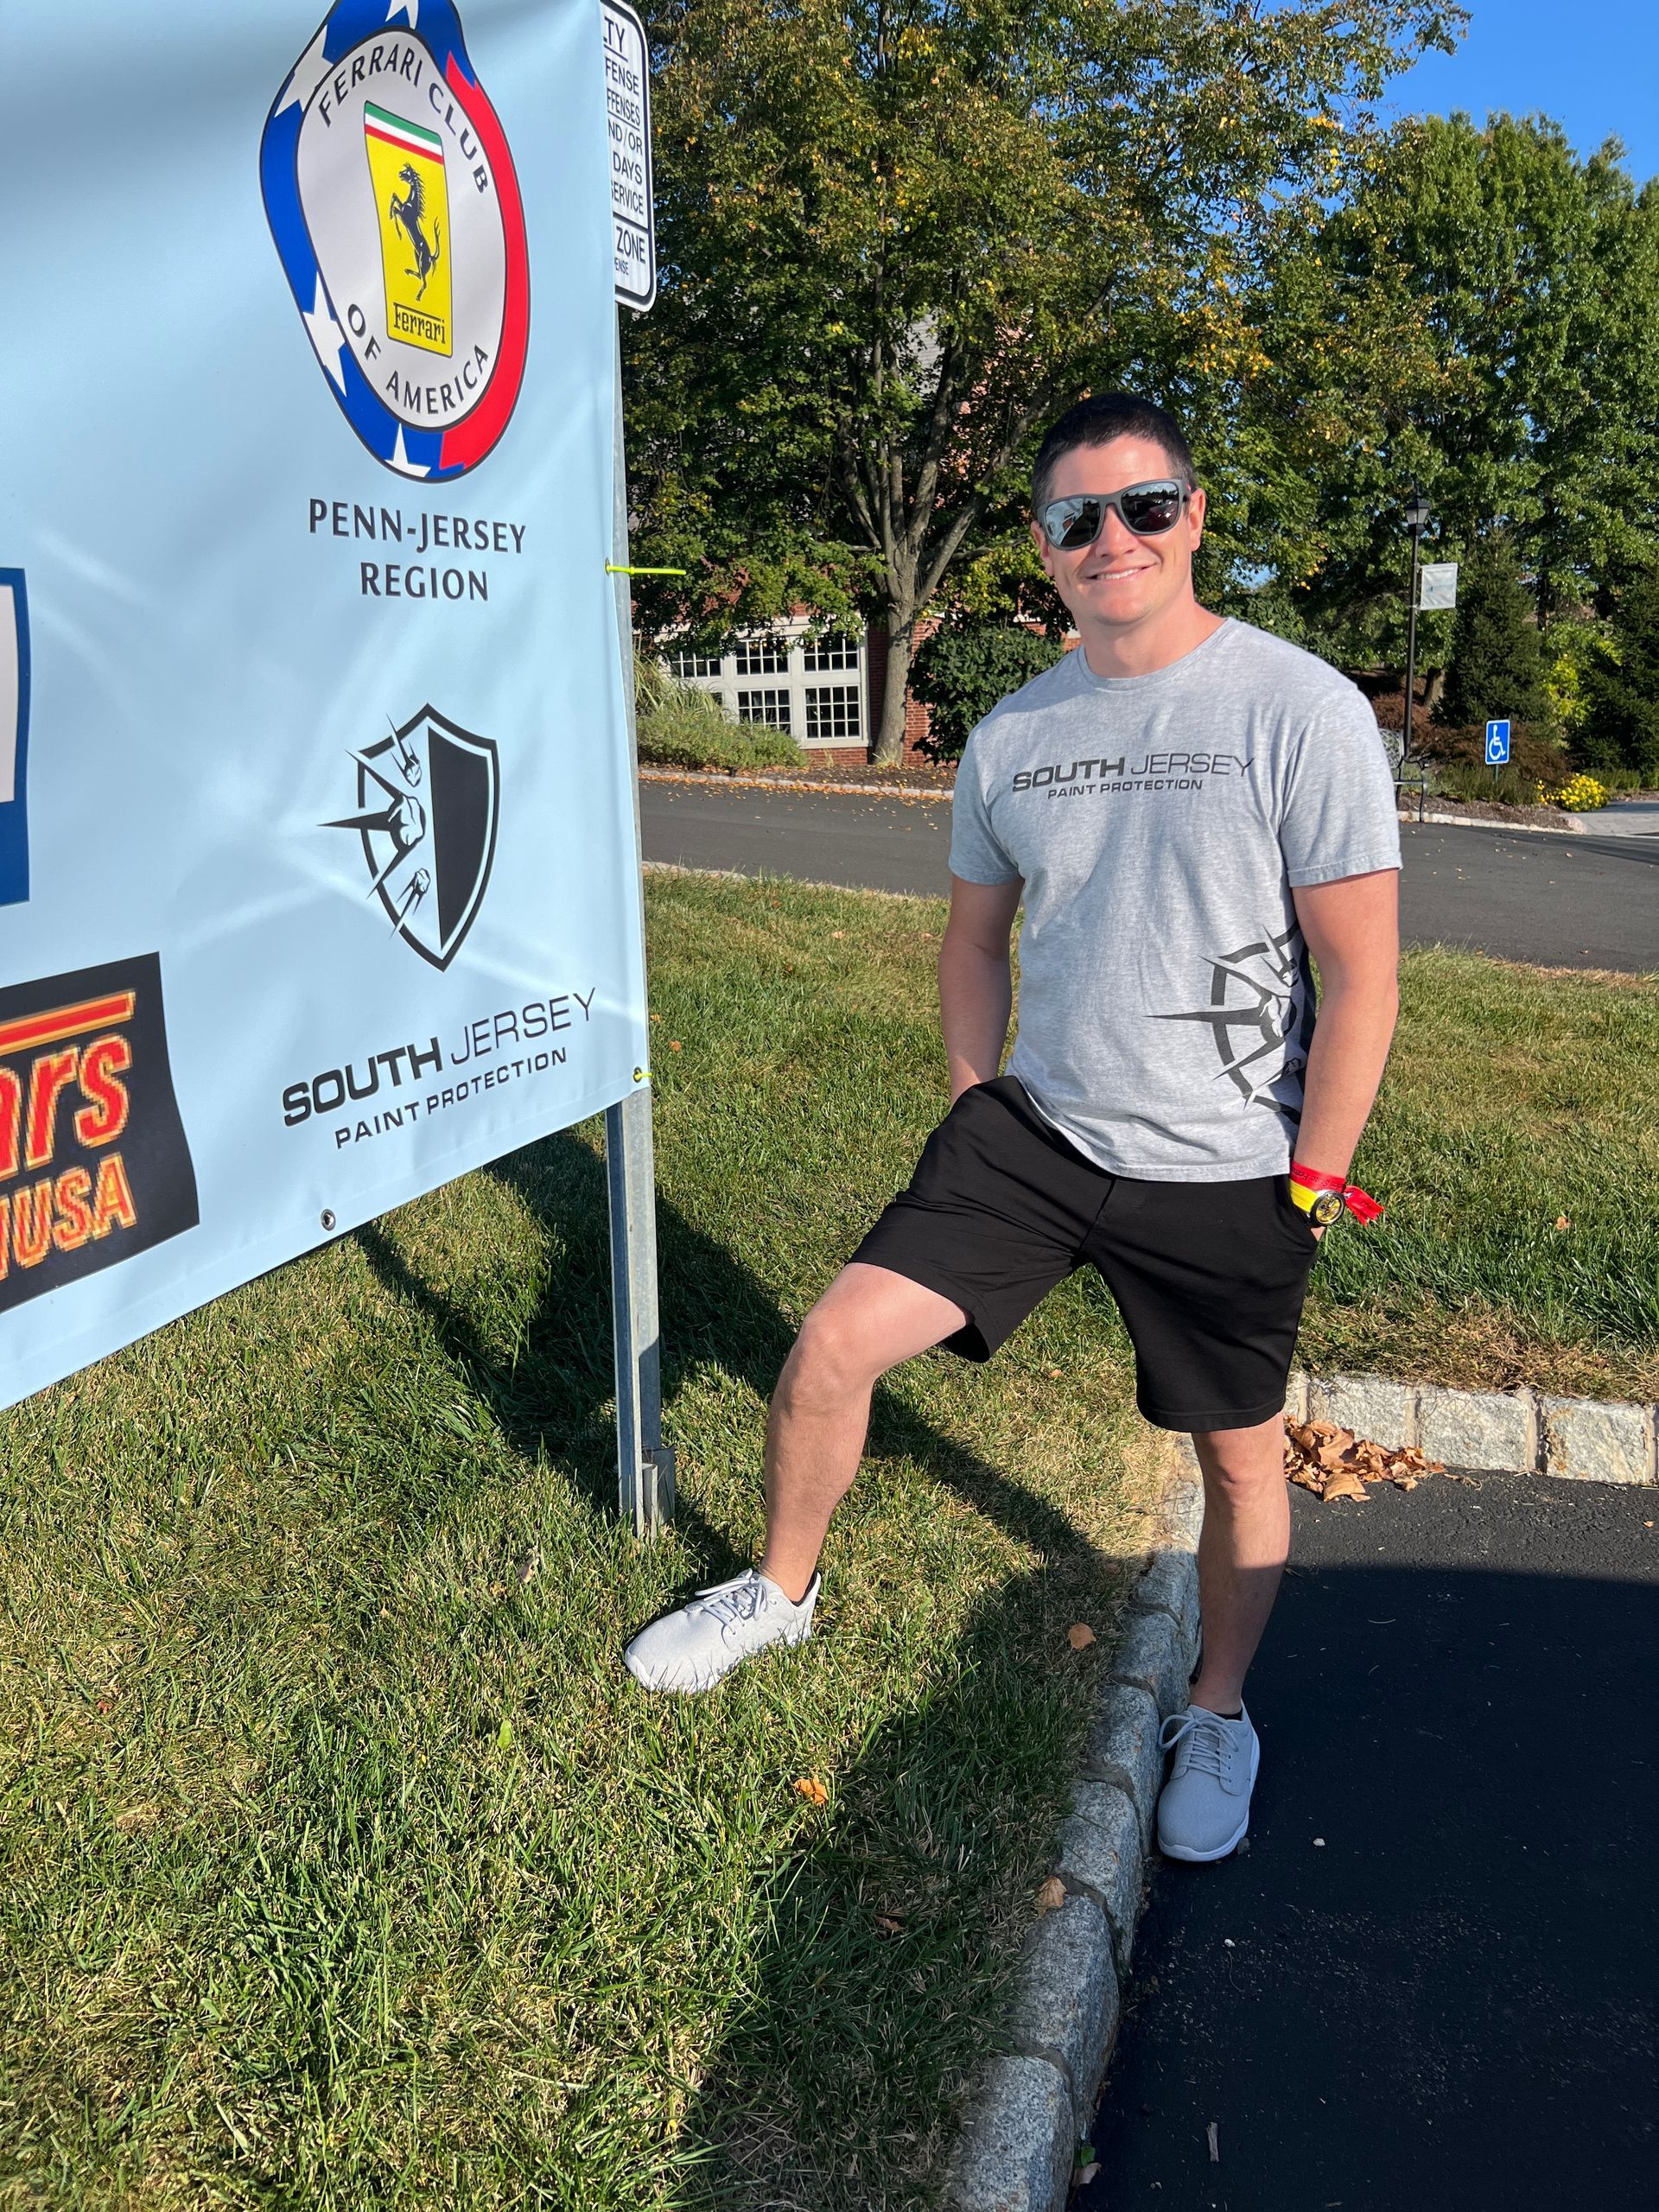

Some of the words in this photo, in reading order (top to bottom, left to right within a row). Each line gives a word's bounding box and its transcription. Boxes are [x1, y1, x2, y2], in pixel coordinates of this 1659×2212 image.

[603, 16, 625, 53] TY
[605, 55, 639, 97] FENSE
[317, 43, 423, 127] FERRARI
[428, 79, 490, 195] CLUB
[607, 87, 640, 126] FFENSES
[608, 118, 643, 156] ND/OR
[613, 151, 642, 186] DAYS
[616, 226, 646, 264] ZONE
[614, 257, 629, 276] ENSE
[392, 302, 447, 345] Ferrari
[347, 303, 381, 360] OF
[386, 344, 488, 416] AMERICA
[308, 498, 526, 555] PENN-JERSEY
[359, 562, 489, 602] REGION
[1012, 757, 1125, 792] SOUTH
[1130, 753, 1255, 777] JERSEY
[1047, 785, 1096, 799] PAINT
[1100, 779, 1203, 794] PROTECTION
[282, 1037, 442, 1127] SOUTH
[450, 987, 597, 1065] JERSEY
[334, 1103, 420, 1150] PAINT
[427, 1046, 568, 1116] PROTECTION
